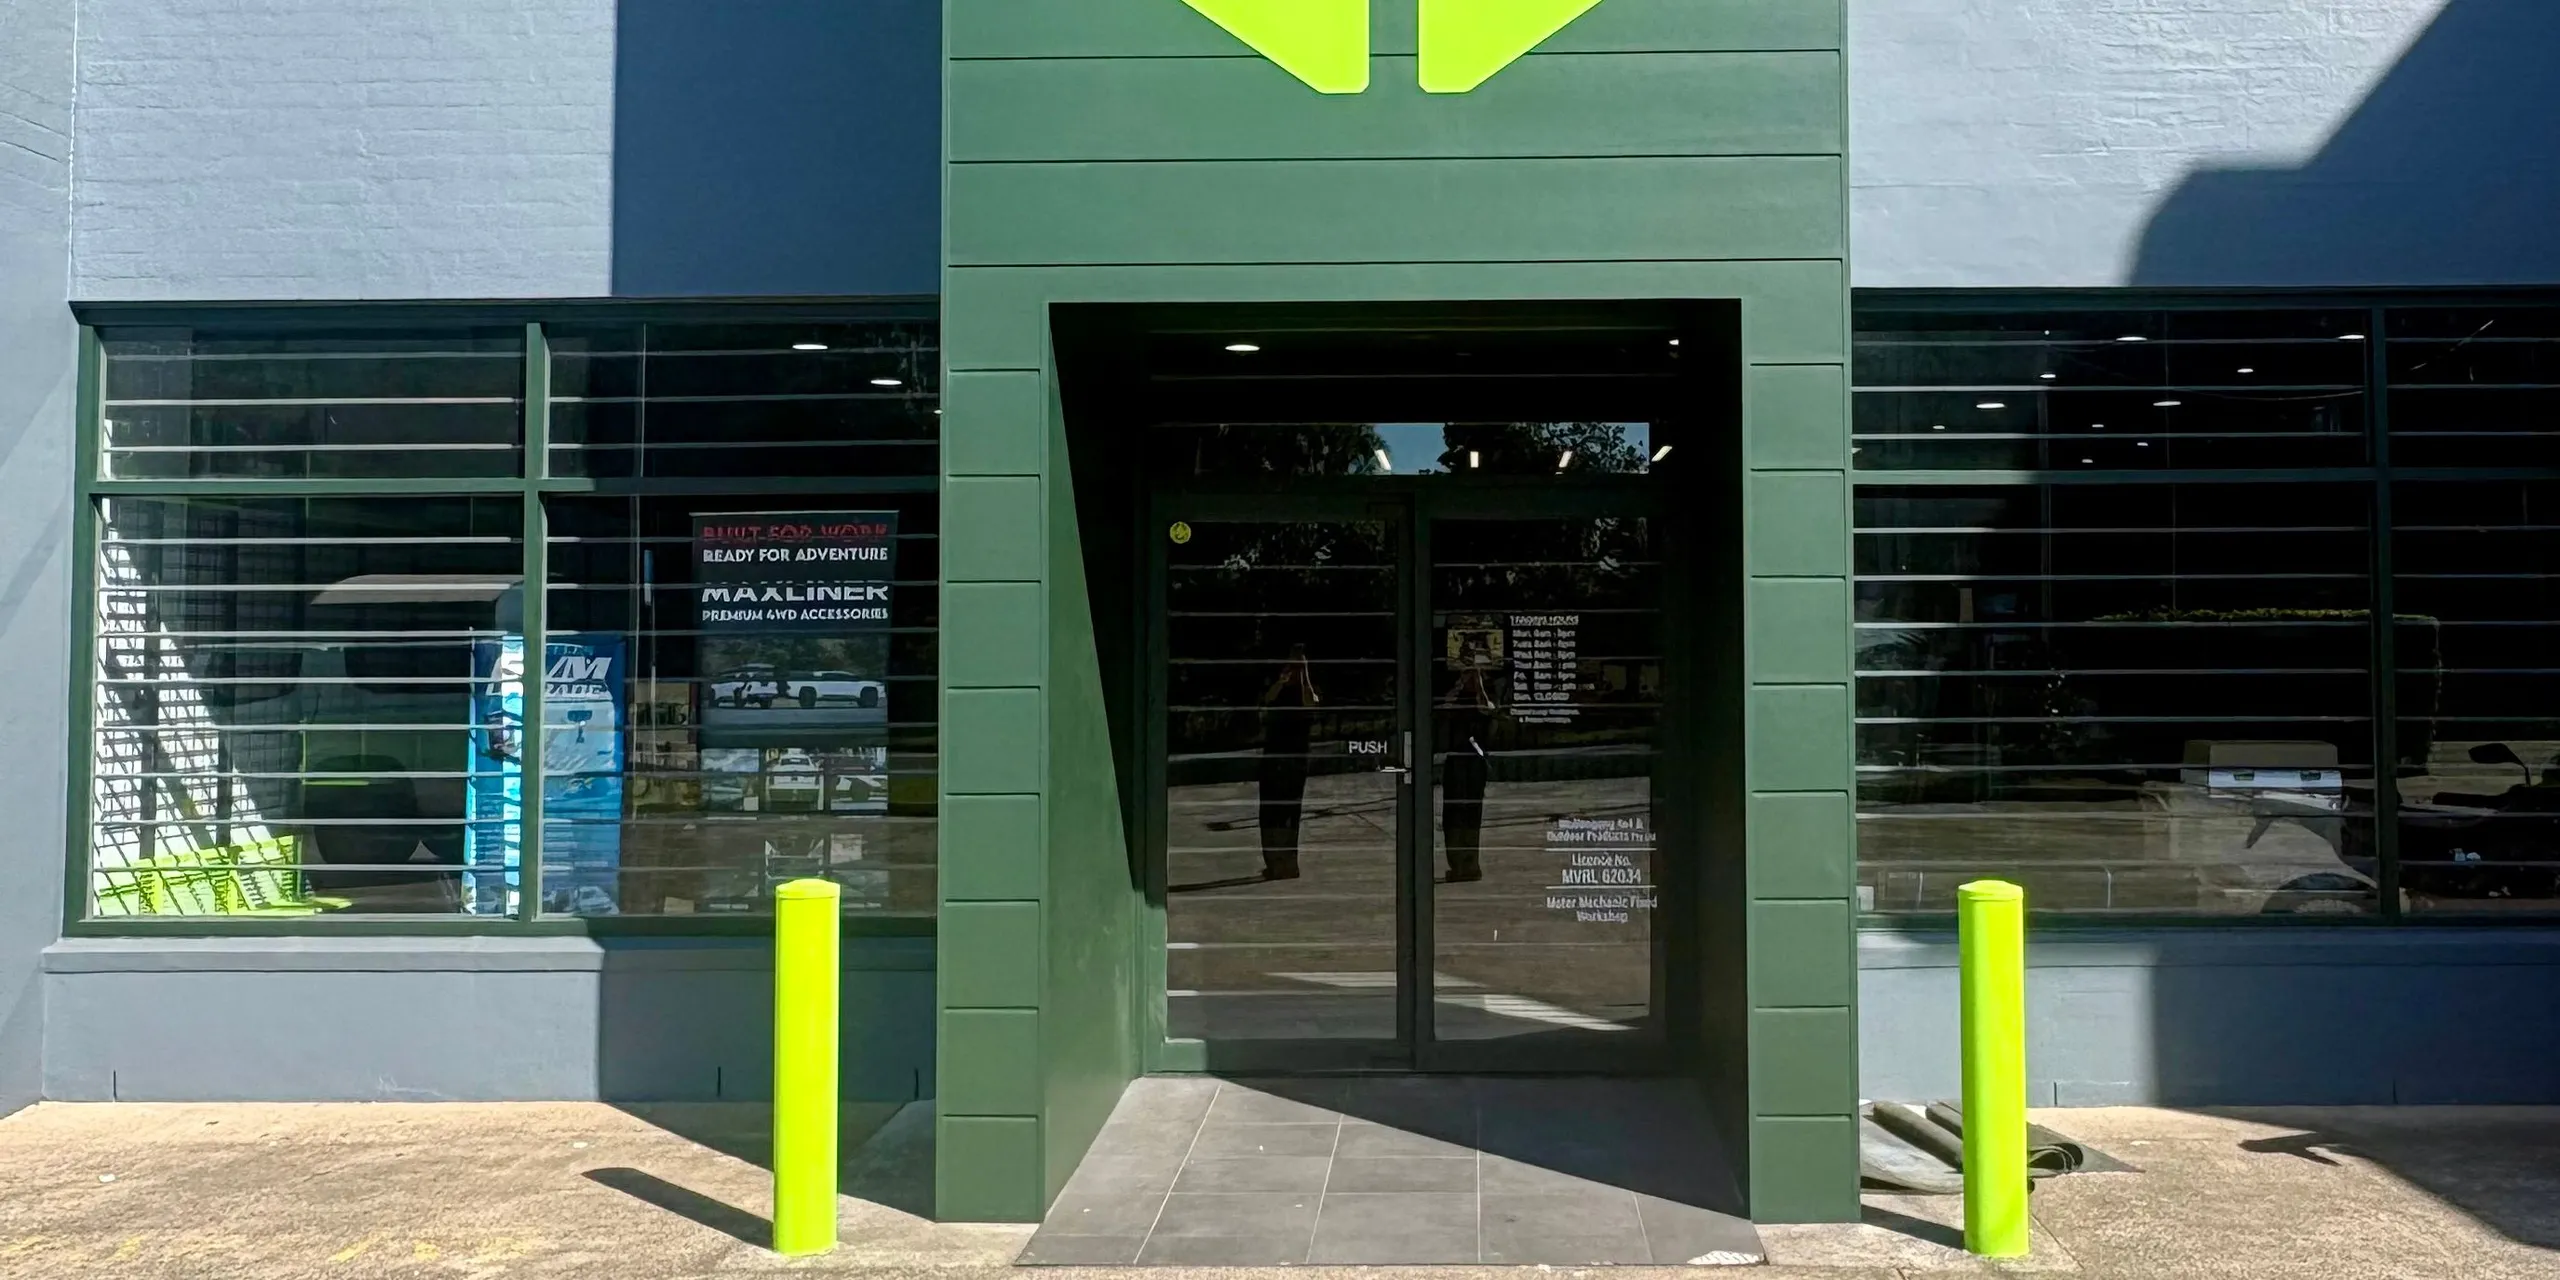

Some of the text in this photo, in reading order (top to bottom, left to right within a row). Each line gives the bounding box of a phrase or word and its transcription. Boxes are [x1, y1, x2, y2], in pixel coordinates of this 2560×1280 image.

[703, 547, 888, 562] READY FOR ADVENTURE
[701, 580, 889, 602] MAXLINER
[702, 608, 889, 621] PREMIUM 4WD ACCESSORIES
[1348, 740, 1388, 755] PUSH
